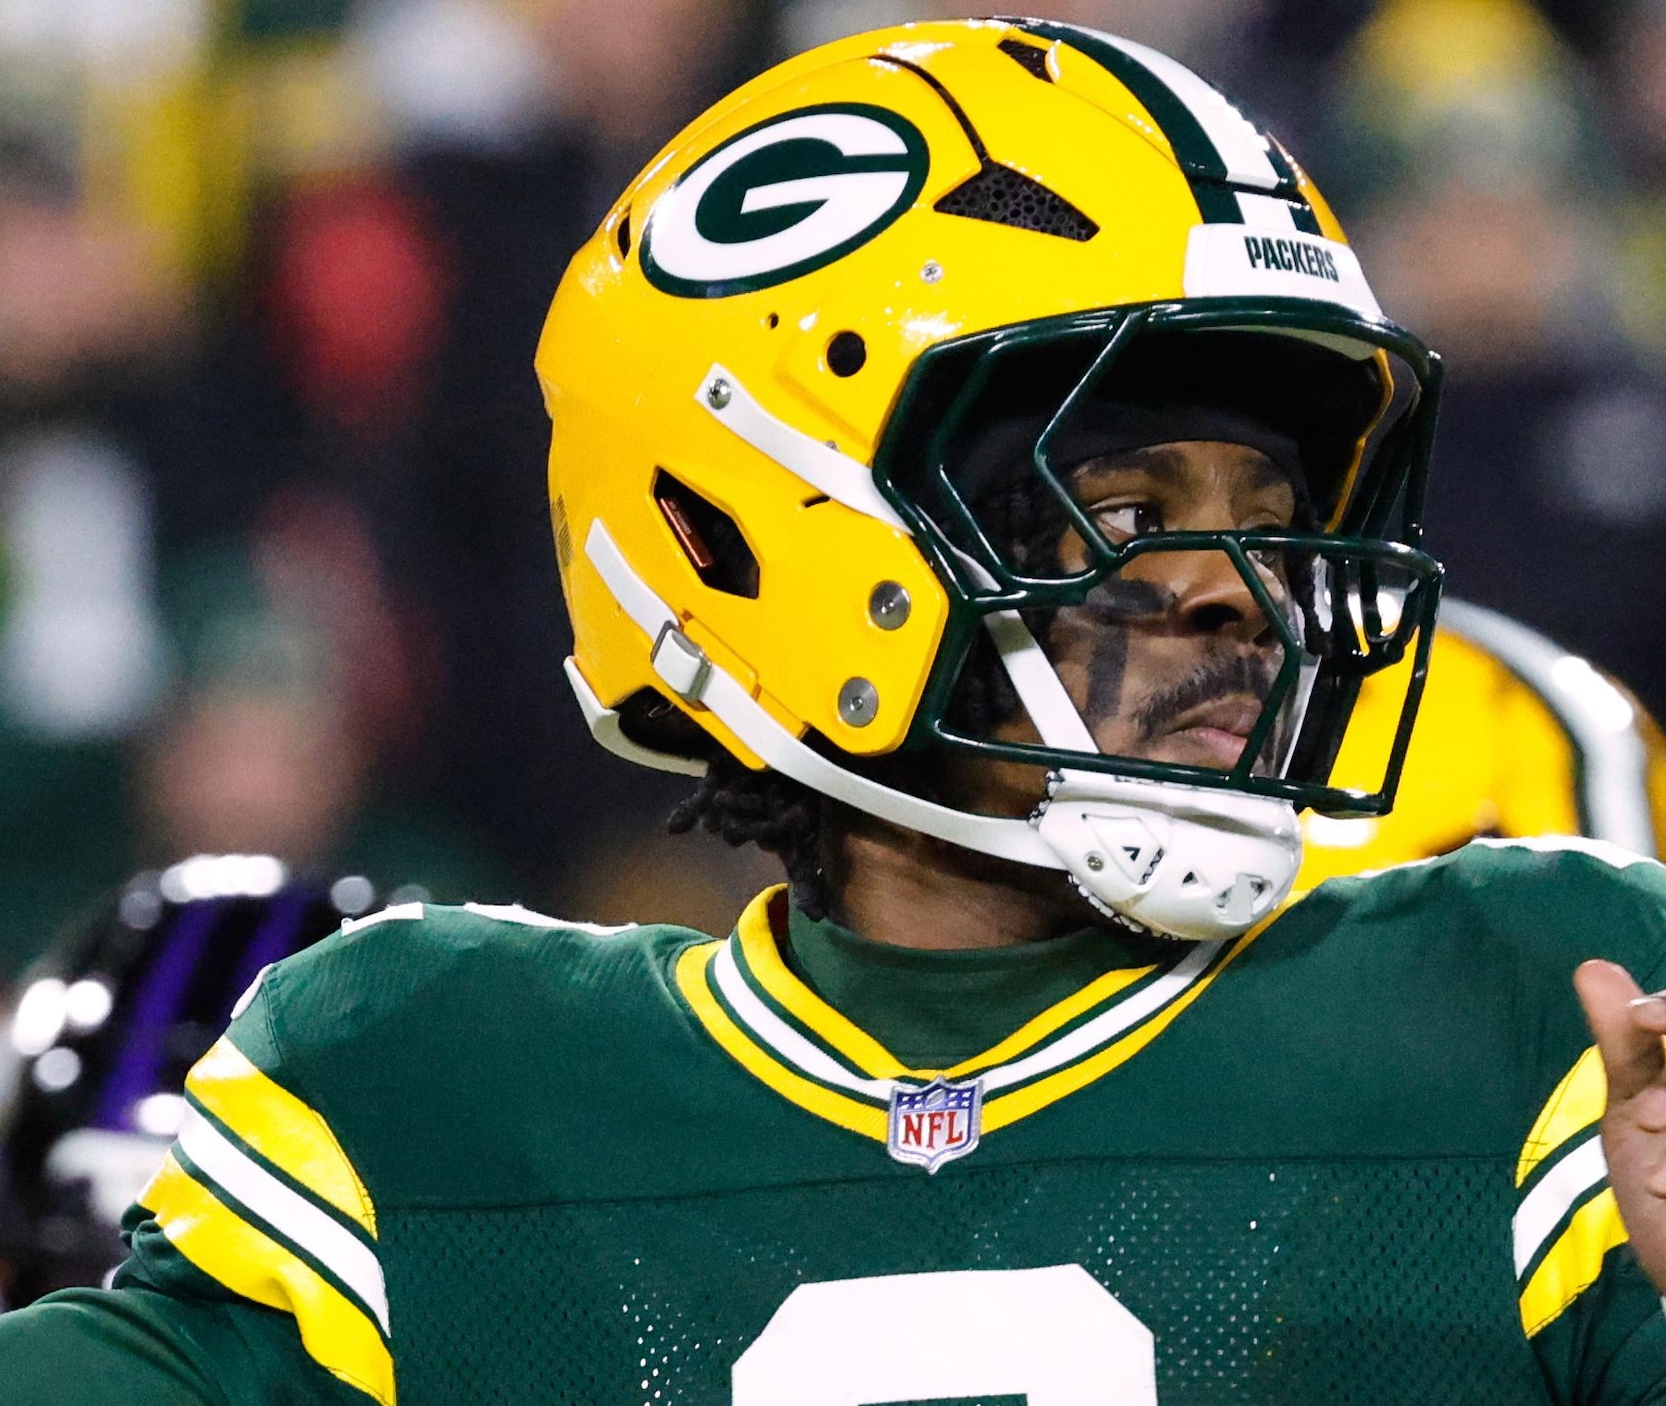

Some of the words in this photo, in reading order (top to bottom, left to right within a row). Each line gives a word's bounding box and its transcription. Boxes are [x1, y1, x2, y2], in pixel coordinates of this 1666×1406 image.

[647, 112, 911, 282] G
[1244, 235, 1340, 282] PACKERS
[902, 1110, 964, 1149] NFL
